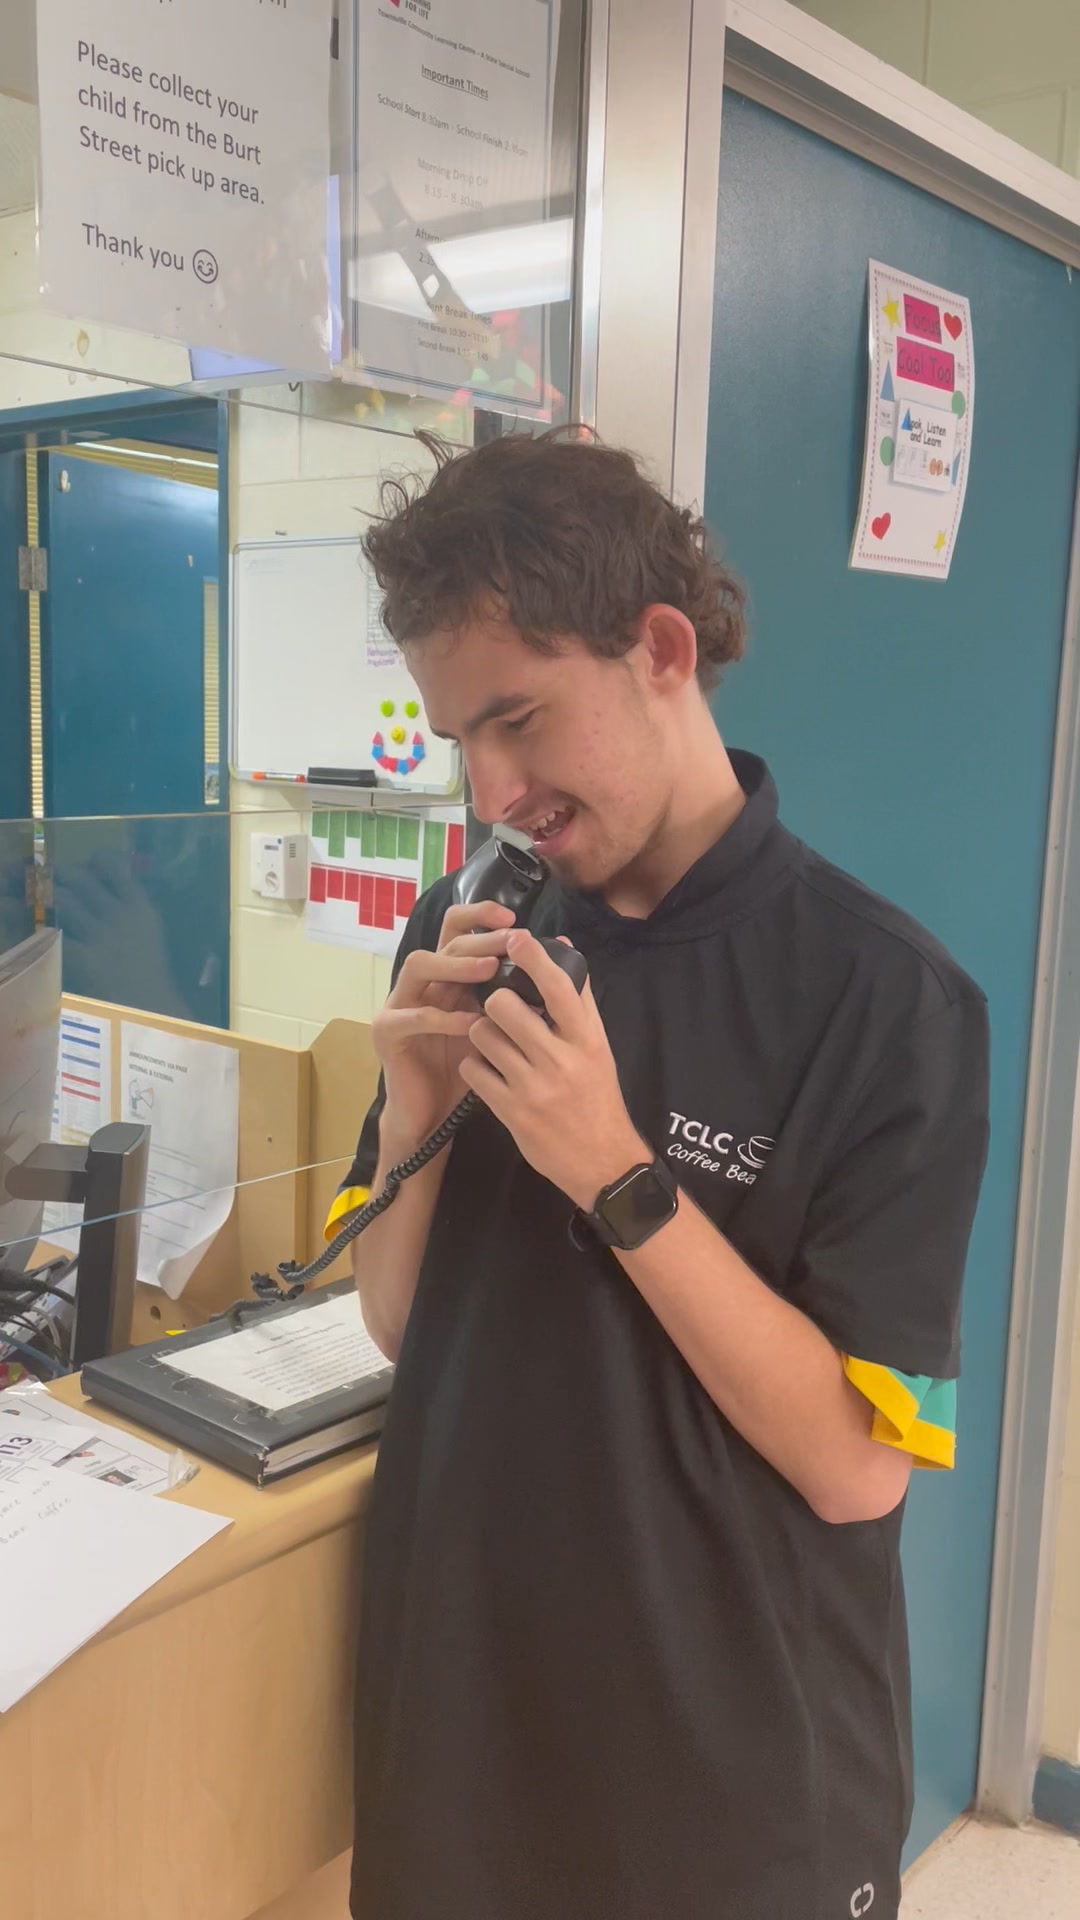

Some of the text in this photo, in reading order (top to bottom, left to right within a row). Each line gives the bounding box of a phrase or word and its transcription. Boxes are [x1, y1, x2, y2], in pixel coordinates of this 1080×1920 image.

[77, 40, 259, 124] Please collect your
[421, 63, 489, 99] Important Times
[78, 85, 261, 165] child from the Burt
[377, 93, 403, 112] School
[405, 104, 420, 120] Start
[456, 124, 481, 141] School
[483, 133, 503, 149] Finish
[79, 125, 265, 205] Street pick up area.
[417, 156, 451, 181] Morning
[82, 222, 184, 272] Thank you
[904, 303, 941, 337] Focus
[897, 348, 924, 375] Cool
[910, 432, 942, 448] and Learn
[926, 420, 947, 437] Listen
[669, 1111, 734, 1155] TCLC
[667, 1143, 757, 1186] Coffee Bea
